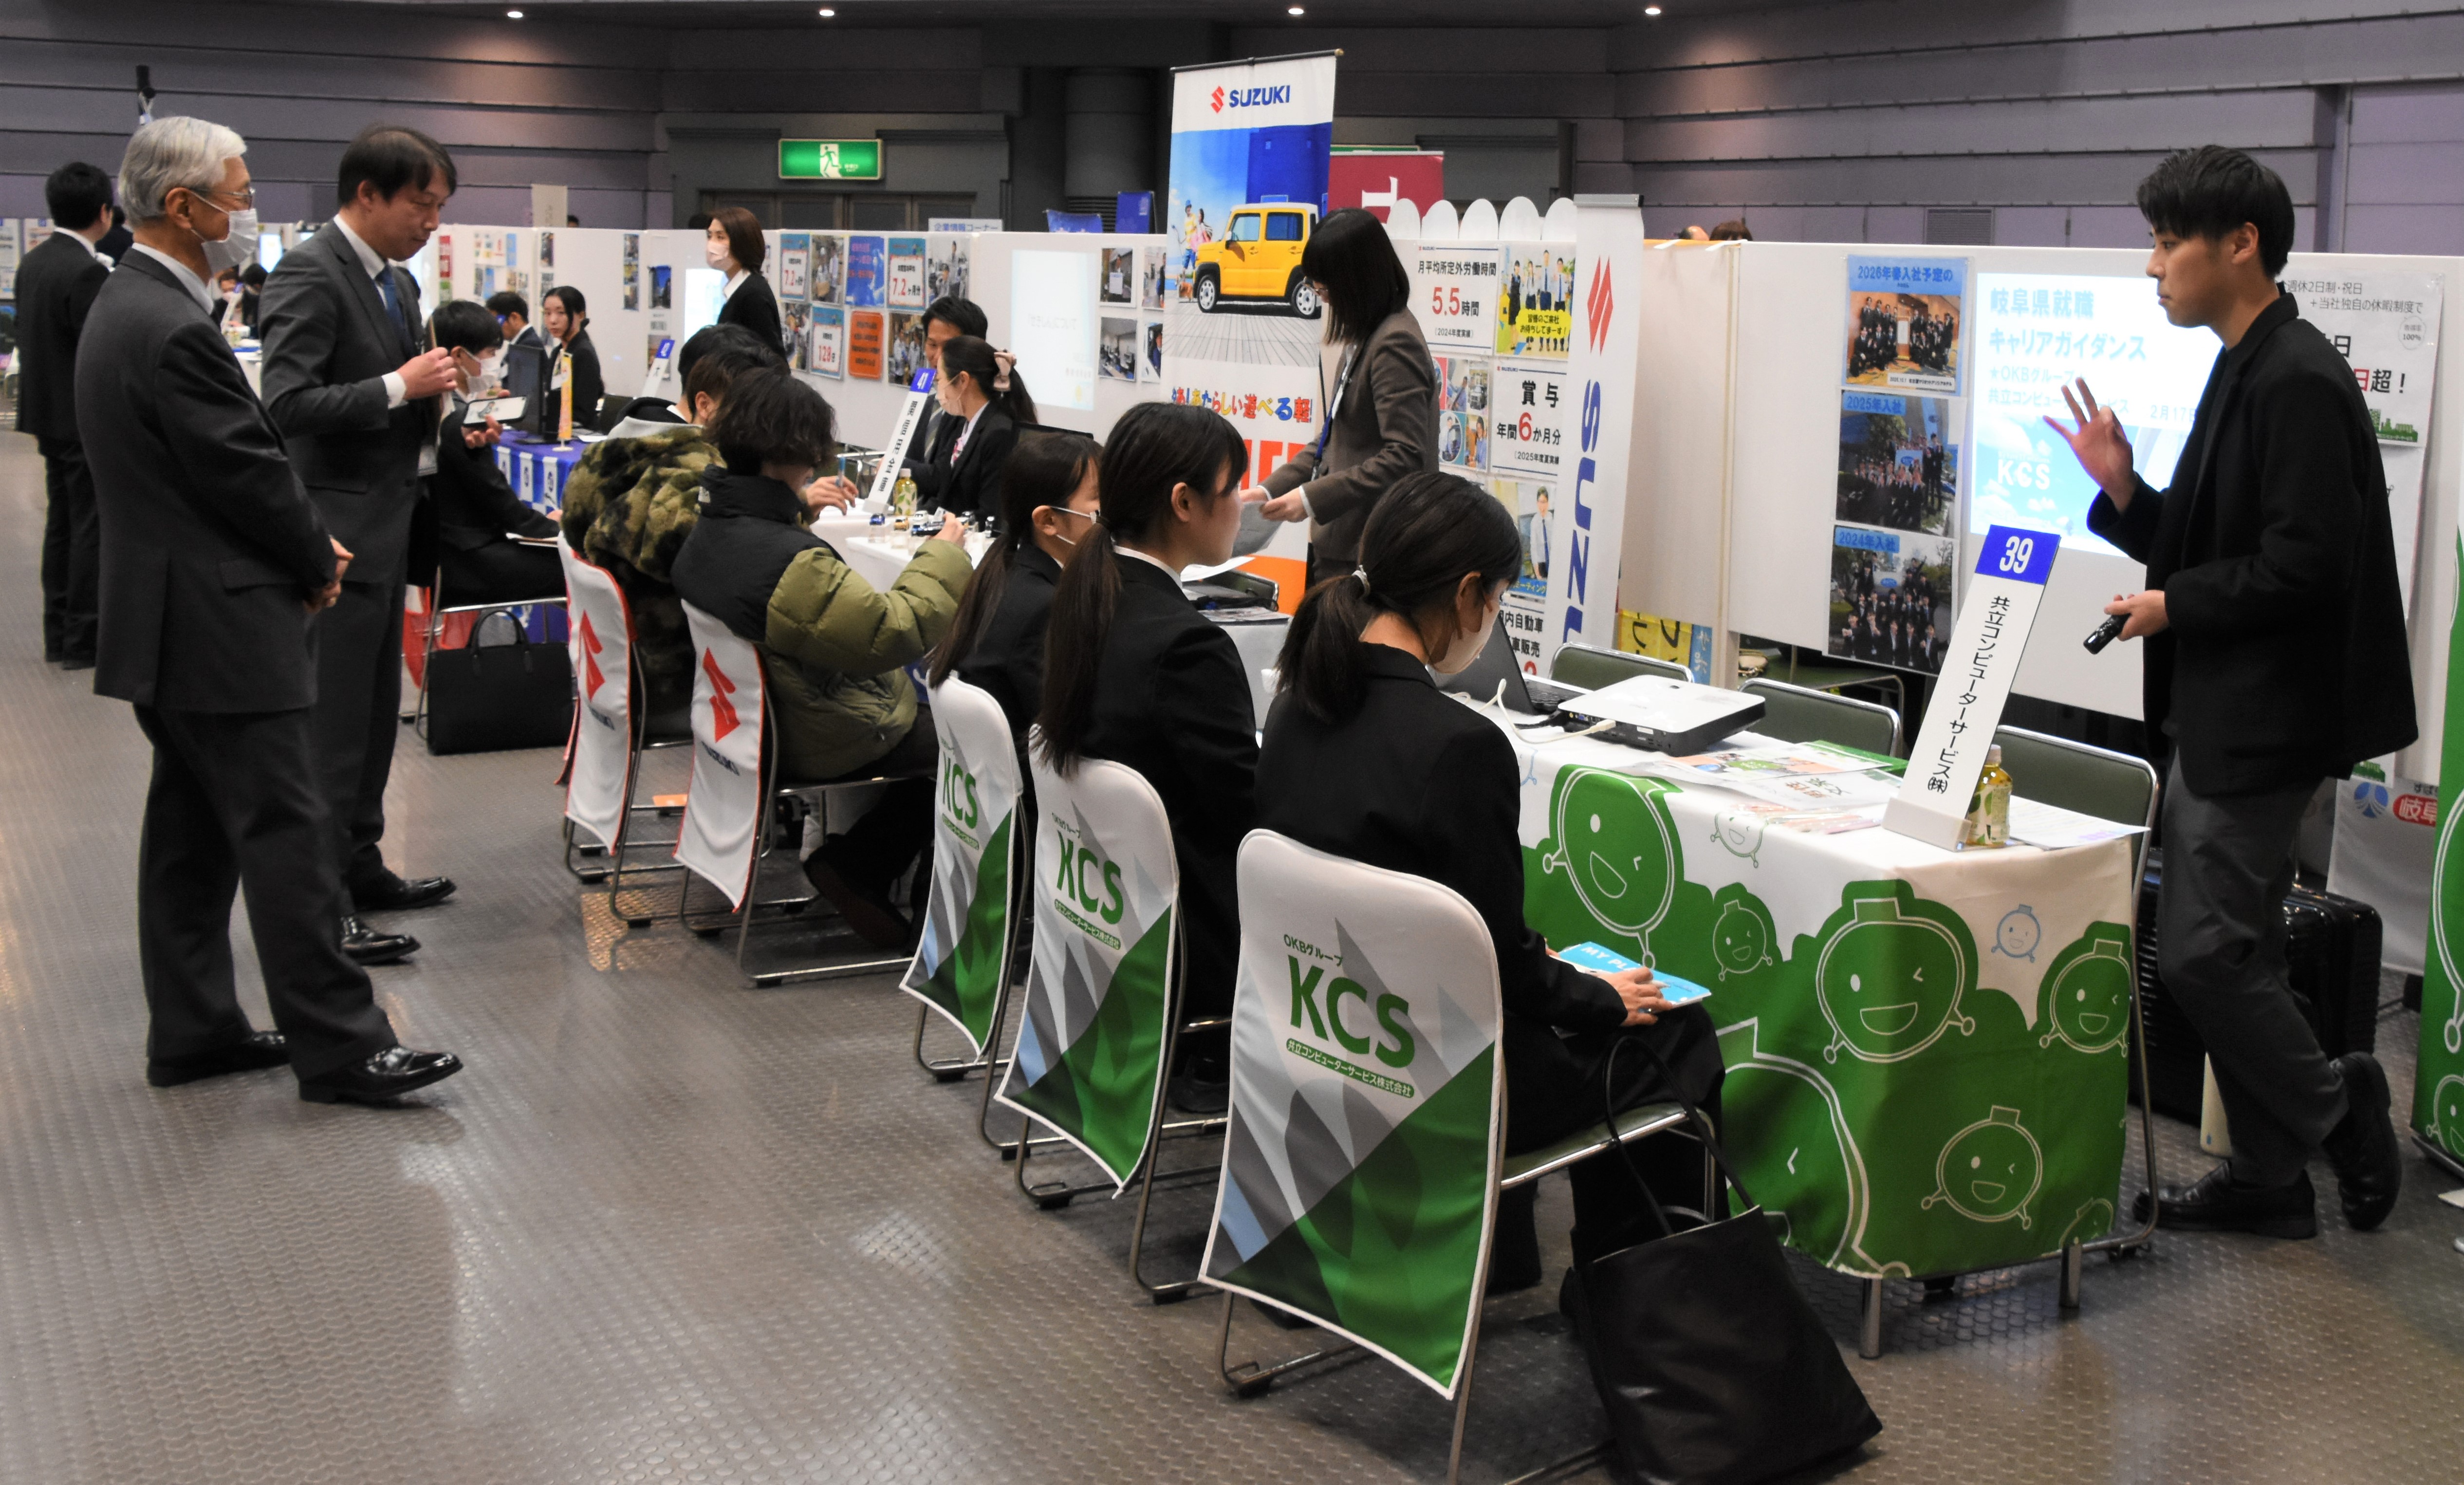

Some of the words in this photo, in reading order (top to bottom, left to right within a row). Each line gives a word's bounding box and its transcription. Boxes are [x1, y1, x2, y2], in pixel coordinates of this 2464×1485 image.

[1229, 85, 1291, 108] SUZUKI
[1418, 260, 1497, 276] 月平均所定外労働時間
[1858, 265, 1953, 282] 2026年春入社予定の
[1432, 286, 1480, 316] 5.5時間
[1990, 287, 2094, 318] 岐阜県就職
[2283, 281, 2362, 294] 週休2日制・祝日
[1989, 328, 2147, 360] キャリアガイダンス
[916, 372, 929, 390] 41
[2001, 365, 2075, 385] OKBグループ
[1846, 396, 1901, 414] 2025年入社
[1497, 412, 1561, 446] 年間6か月分
[1998, 459, 2050, 490] KCS
[1838, 533, 1896, 551] 2024年入社
[1999, 536, 2034, 574] 39
[1508, 635, 1540, 658] 車販売
[942, 751, 978, 830] KCS
[1056, 829, 1124, 925] KCS
[1283, 933, 1344, 967] OKBグループ
[1581, 947, 1610, 959] MY
[1607, 958, 1638, 971] PL
[1288, 954, 1415, 1068] KCS
[1286, 1040, 1414, 1098] 共立コンピューターサービス株式会社
